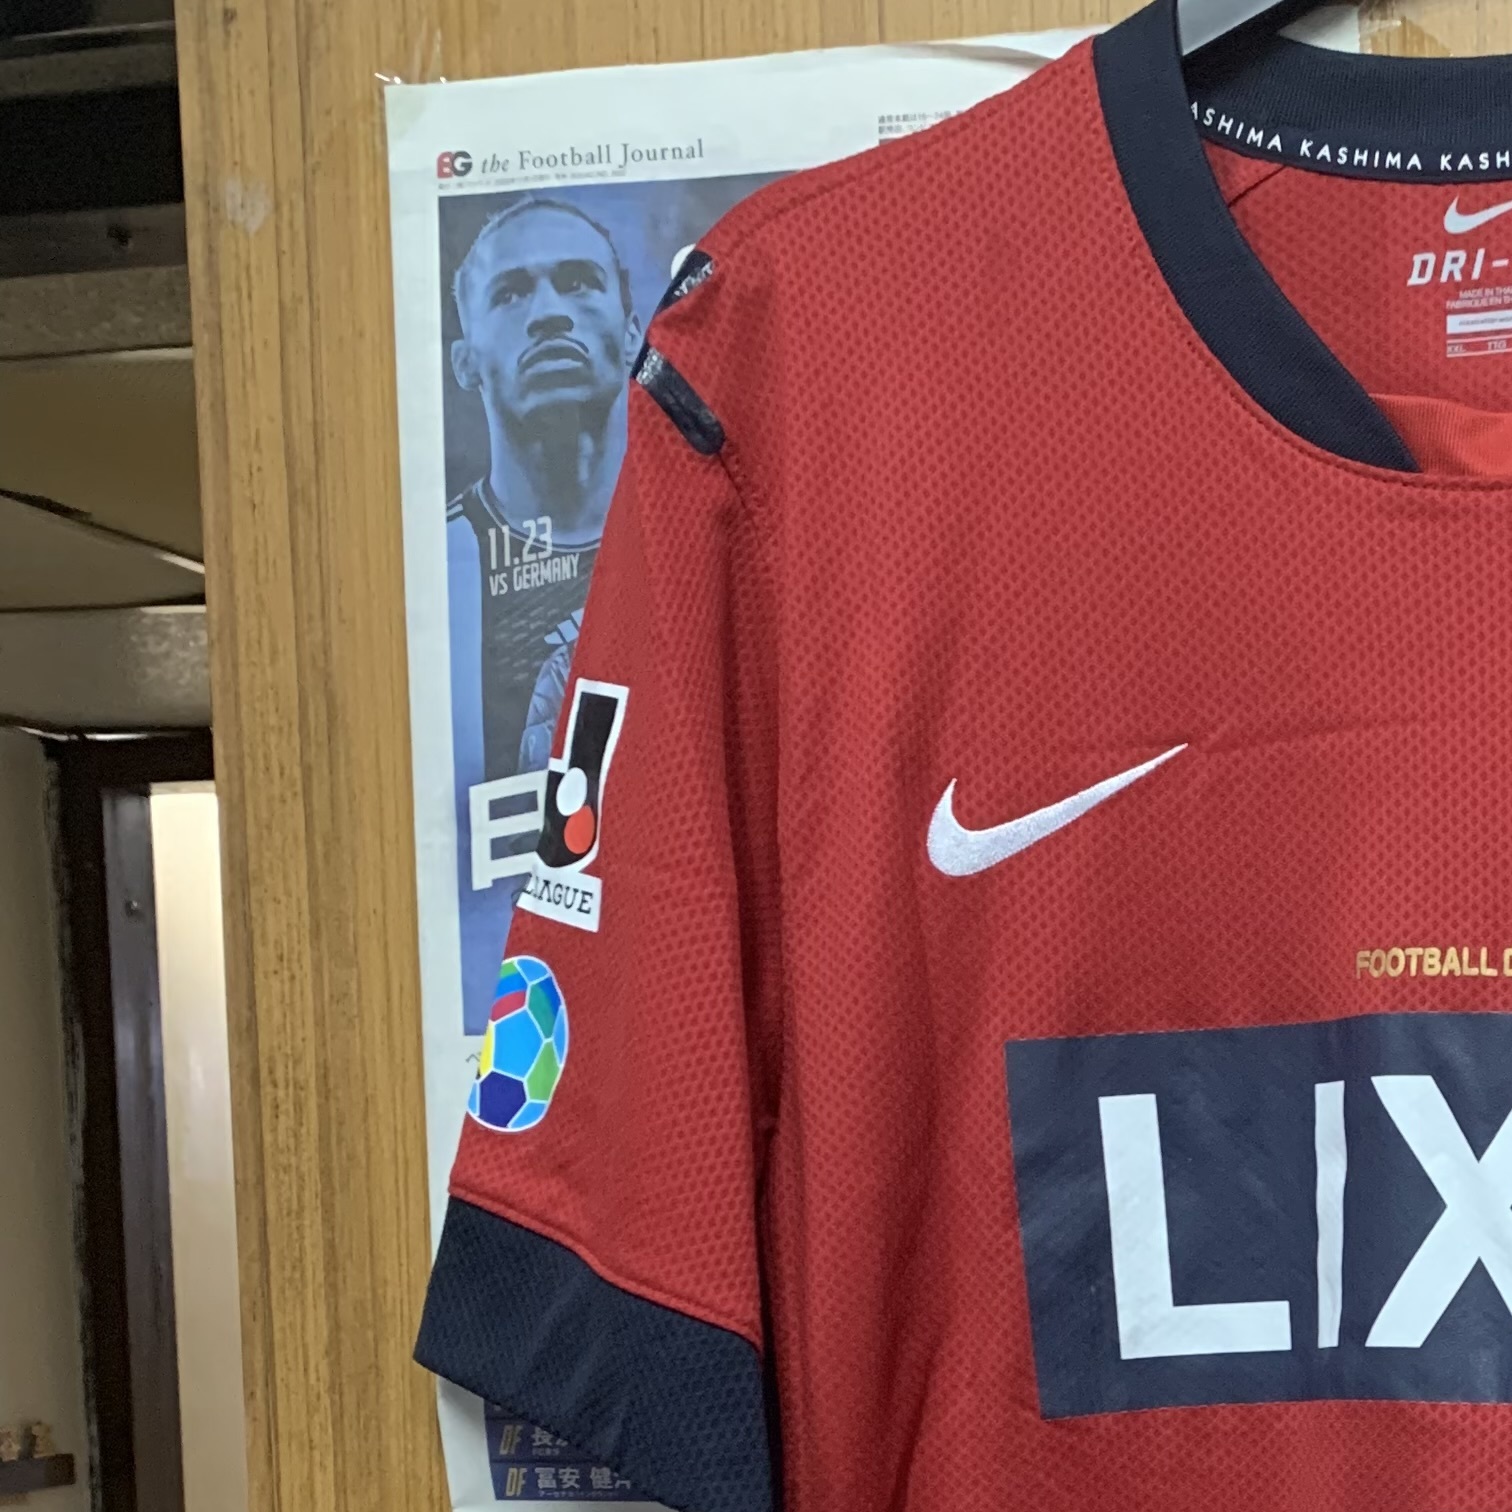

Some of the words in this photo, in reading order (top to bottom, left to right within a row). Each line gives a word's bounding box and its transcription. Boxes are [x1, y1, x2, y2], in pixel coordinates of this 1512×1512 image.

[481, 153, 509, 174] the
[518, 144, 612, 171] Football
[618, 139, 704, 168] Journal
[1300, 139, 1422, 170] KASHIMA
[488, 515, 553, 570] 11.23
[489, 573, 508, 596] VS
[513, 553, 580, 591] GERMANY
[1356, 946, 1498, 979] FOOTBALL
[505, 1467, 527, 1497] DF
